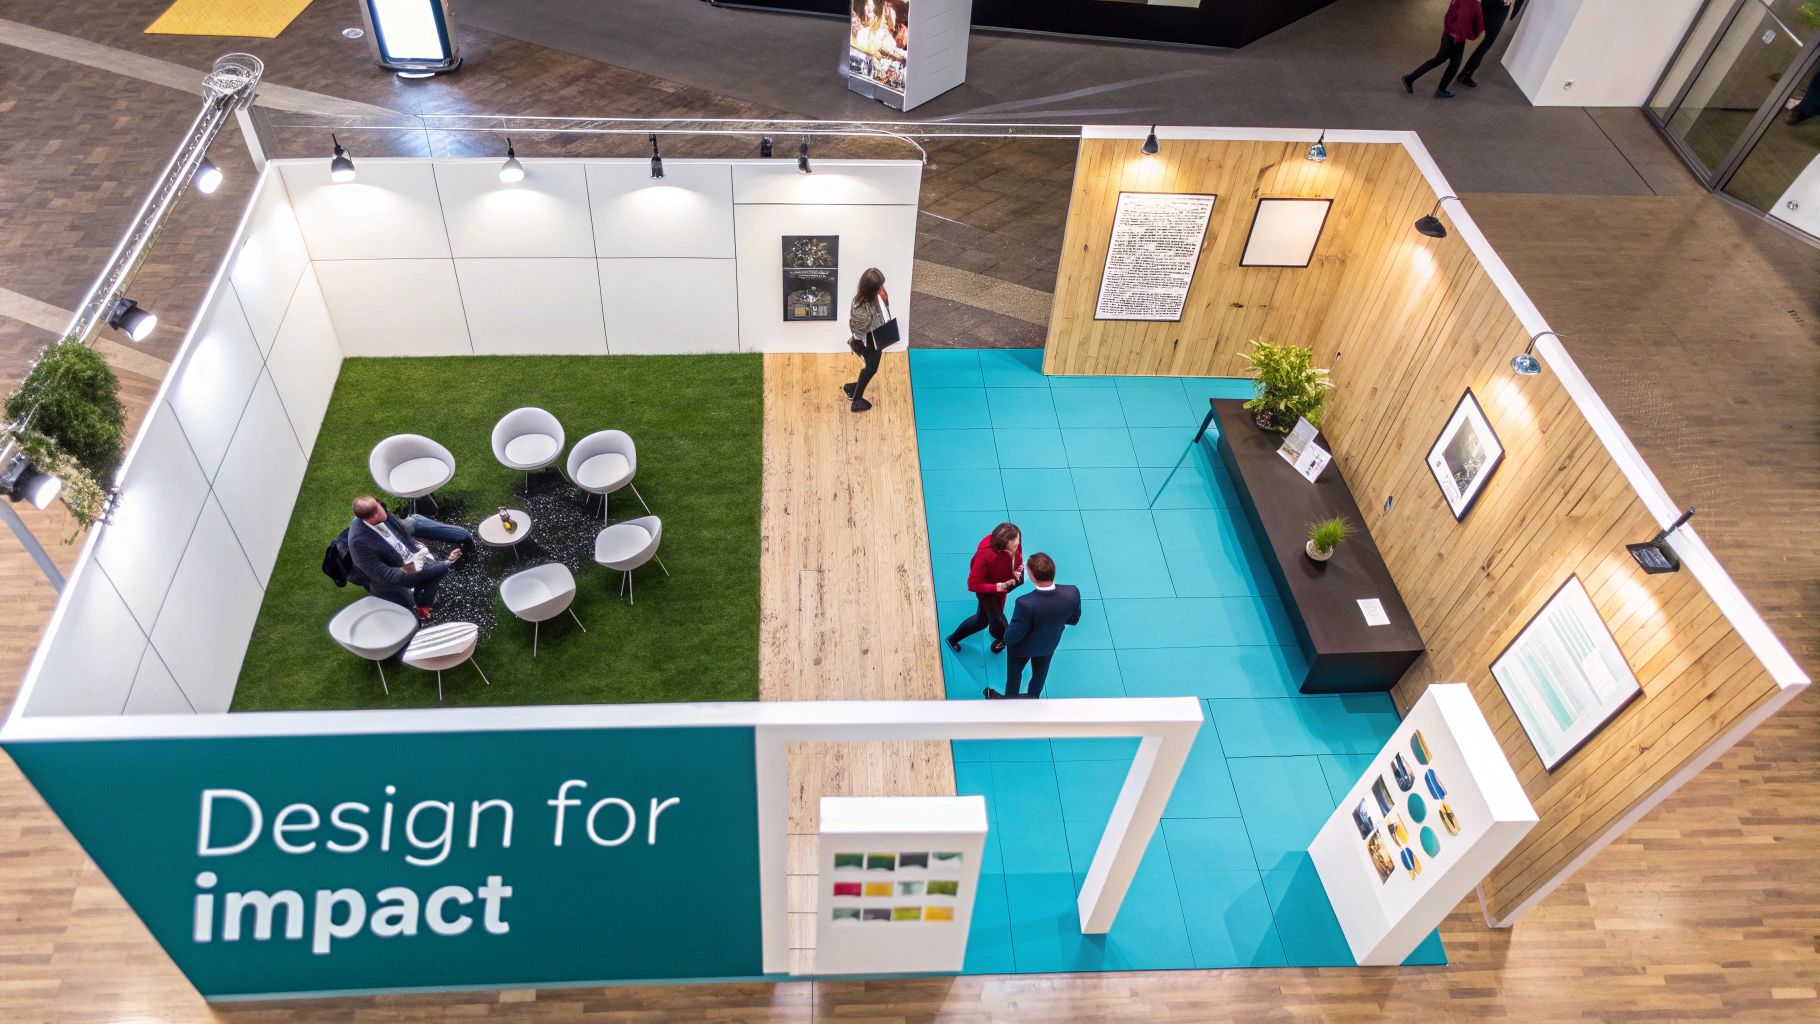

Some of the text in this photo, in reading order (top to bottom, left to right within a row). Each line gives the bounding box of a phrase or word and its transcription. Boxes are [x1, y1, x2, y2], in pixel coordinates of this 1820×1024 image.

[197, 779, 681, 867] Design for
[193, 871, 513, 954] impact
